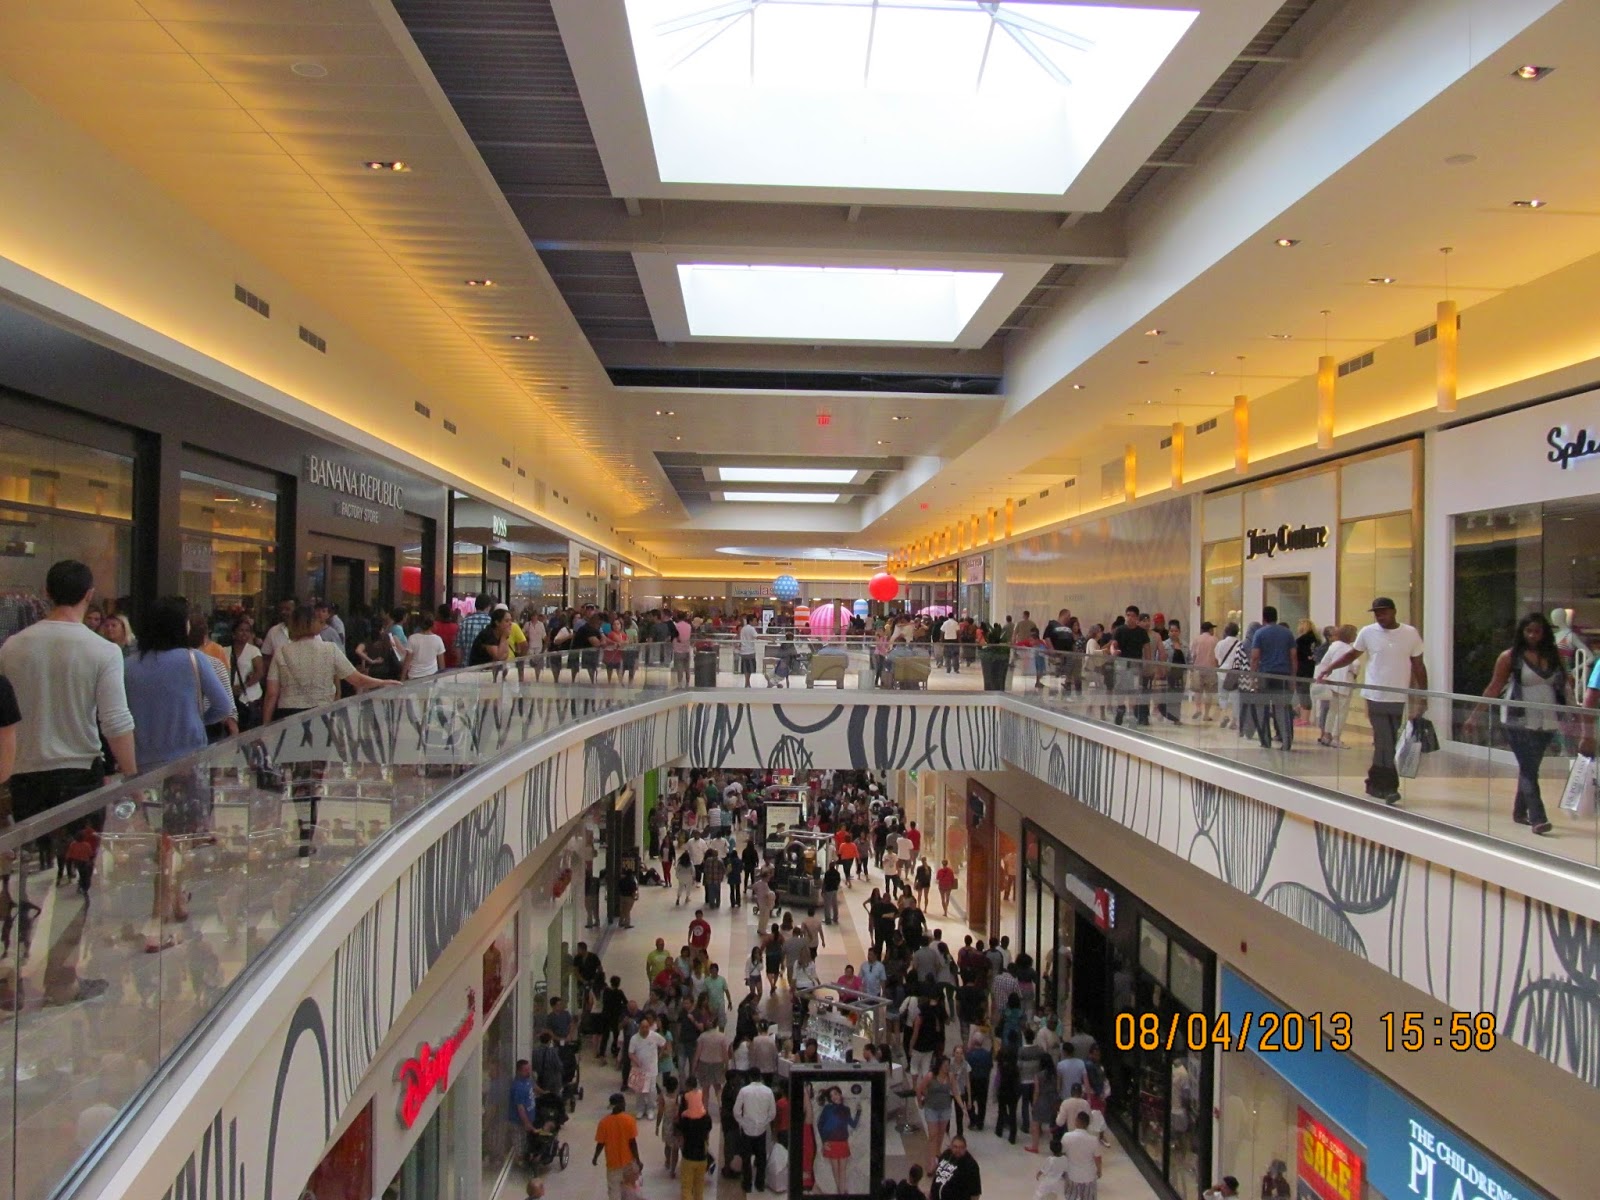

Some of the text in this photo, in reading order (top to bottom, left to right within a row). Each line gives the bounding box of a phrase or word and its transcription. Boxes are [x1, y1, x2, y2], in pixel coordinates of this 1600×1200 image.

[1547, 426, 1600, 470] Sple
[310, 454, 403, 511] BANANA REPUBLIC
[341, 501, 379, 523] FACTORY STORE
[492, 515, 507, 537] BOSS
[1246, 524, 1329, 560] Juicy Couture
[1303, 1130, 1352, 1200] SALE
[1409, 1118, 1519, 1200] THE CHILDREN'
